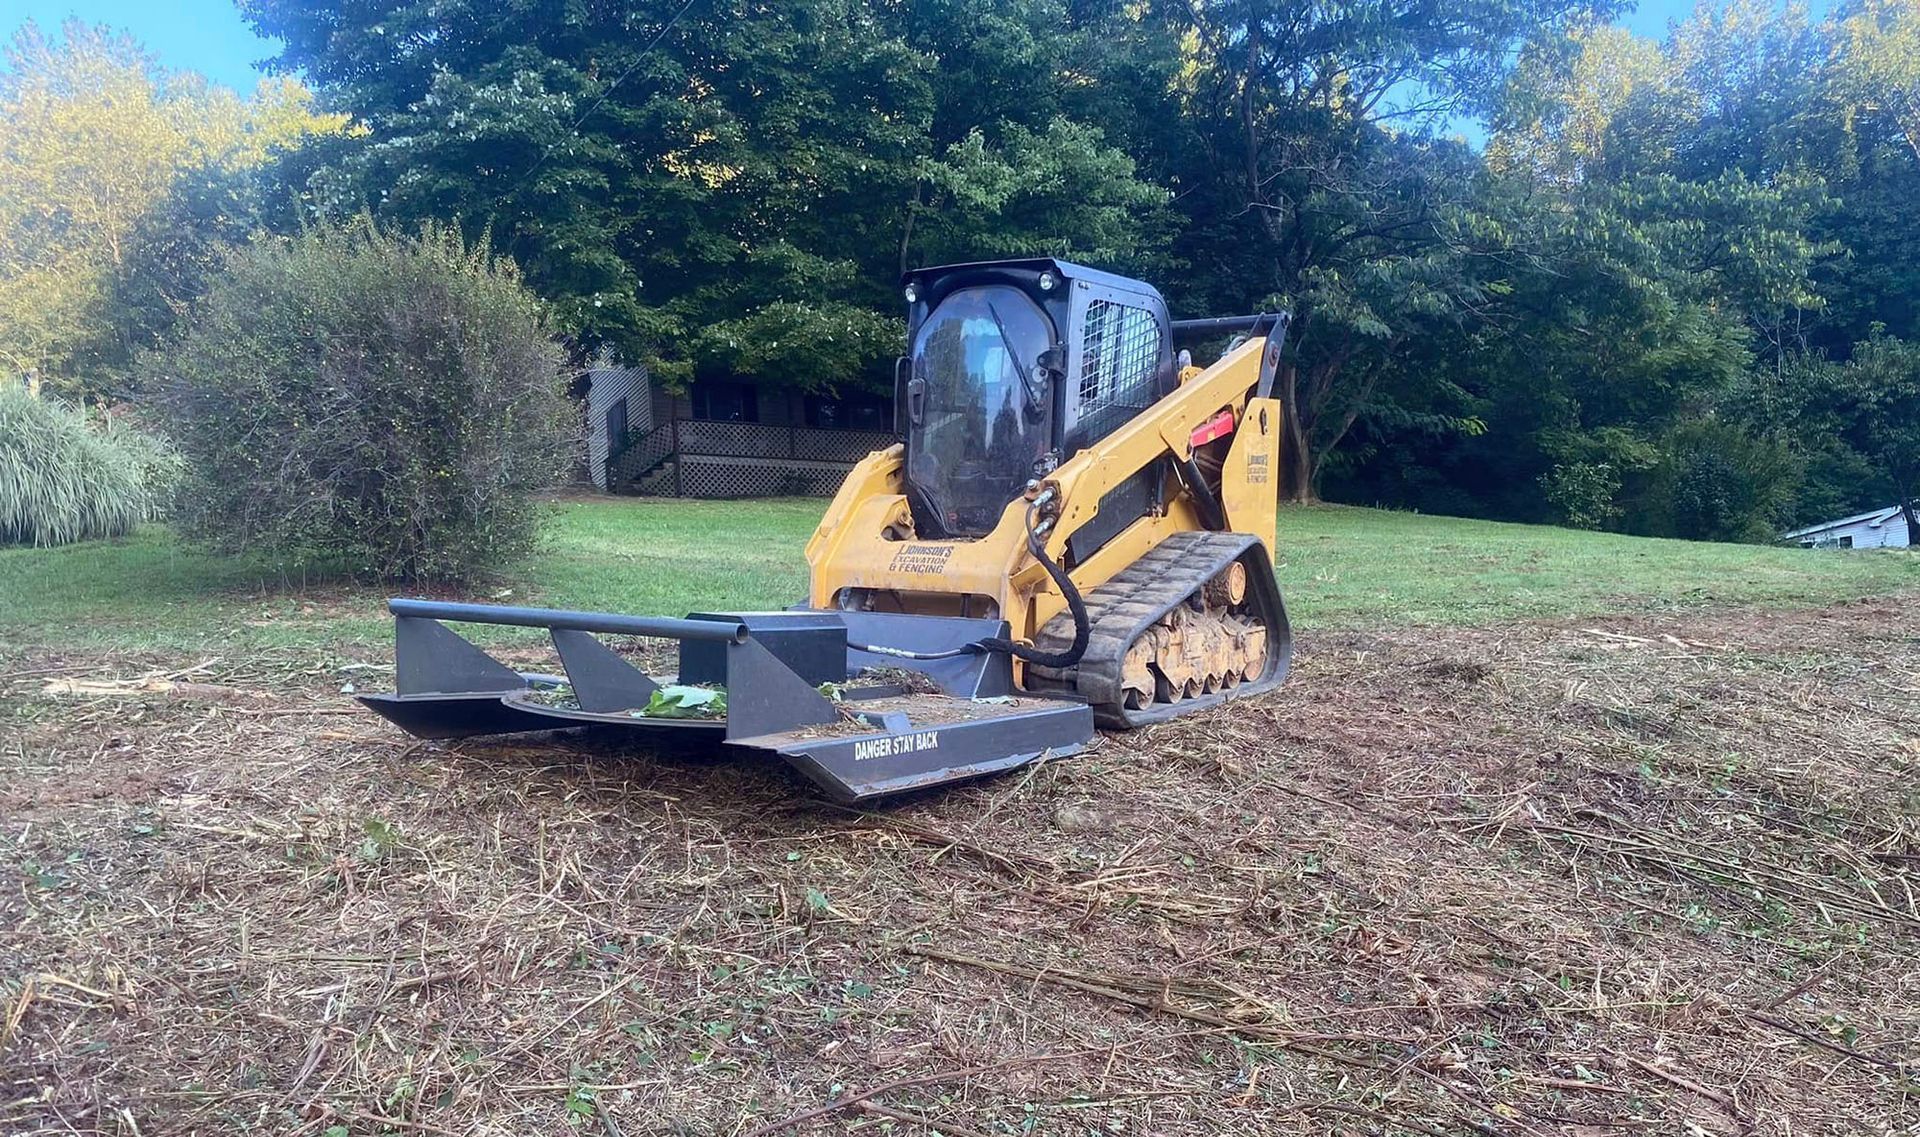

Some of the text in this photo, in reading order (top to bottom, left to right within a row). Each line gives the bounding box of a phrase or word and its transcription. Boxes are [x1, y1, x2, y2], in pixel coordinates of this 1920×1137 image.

[892, 553, 948, 565] EXCAVATION
[889, 562, 944, 574] & FENCING
[855, 731, 938, 761] DANGER STAY BACK
